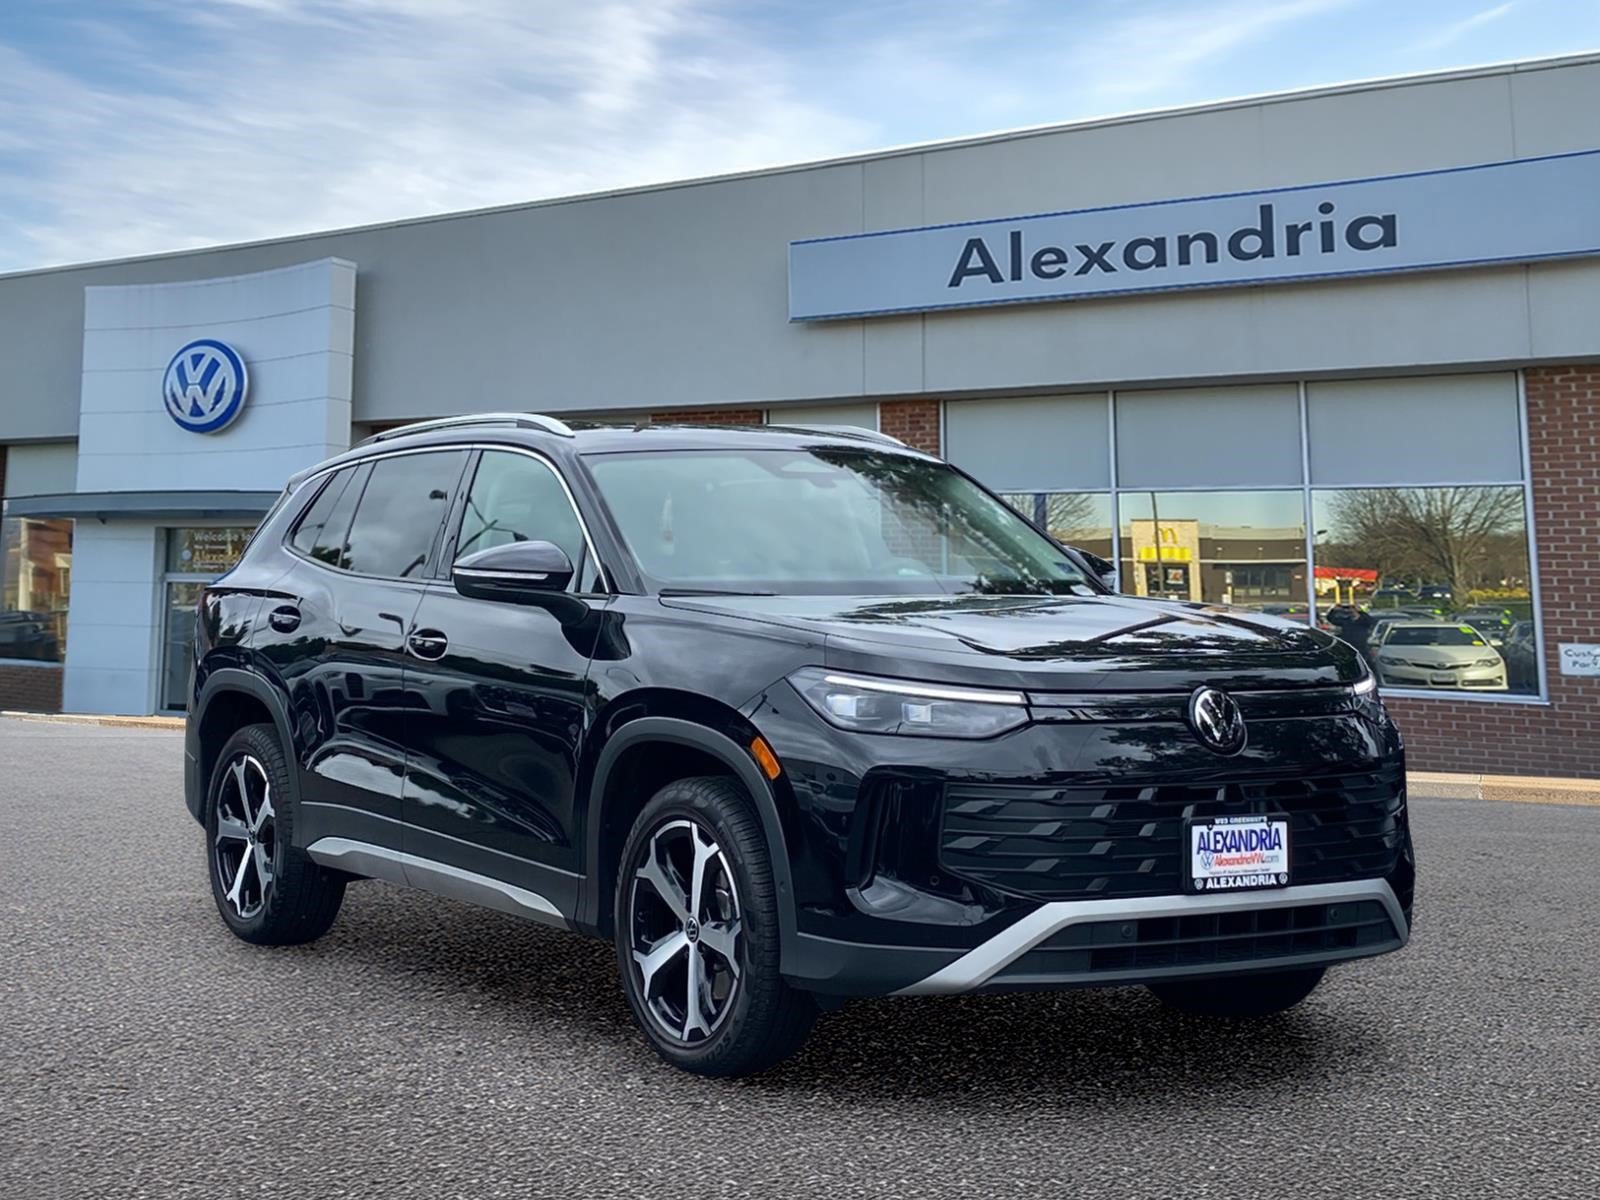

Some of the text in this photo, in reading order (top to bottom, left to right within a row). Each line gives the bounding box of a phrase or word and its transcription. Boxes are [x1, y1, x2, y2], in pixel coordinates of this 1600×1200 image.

[947, 201, 1398, 289] Alexandria
[1196, 827, 1282, 855] ALEXANDRIA
[1206, 874, 1277, 889] ALEXANDRIA
